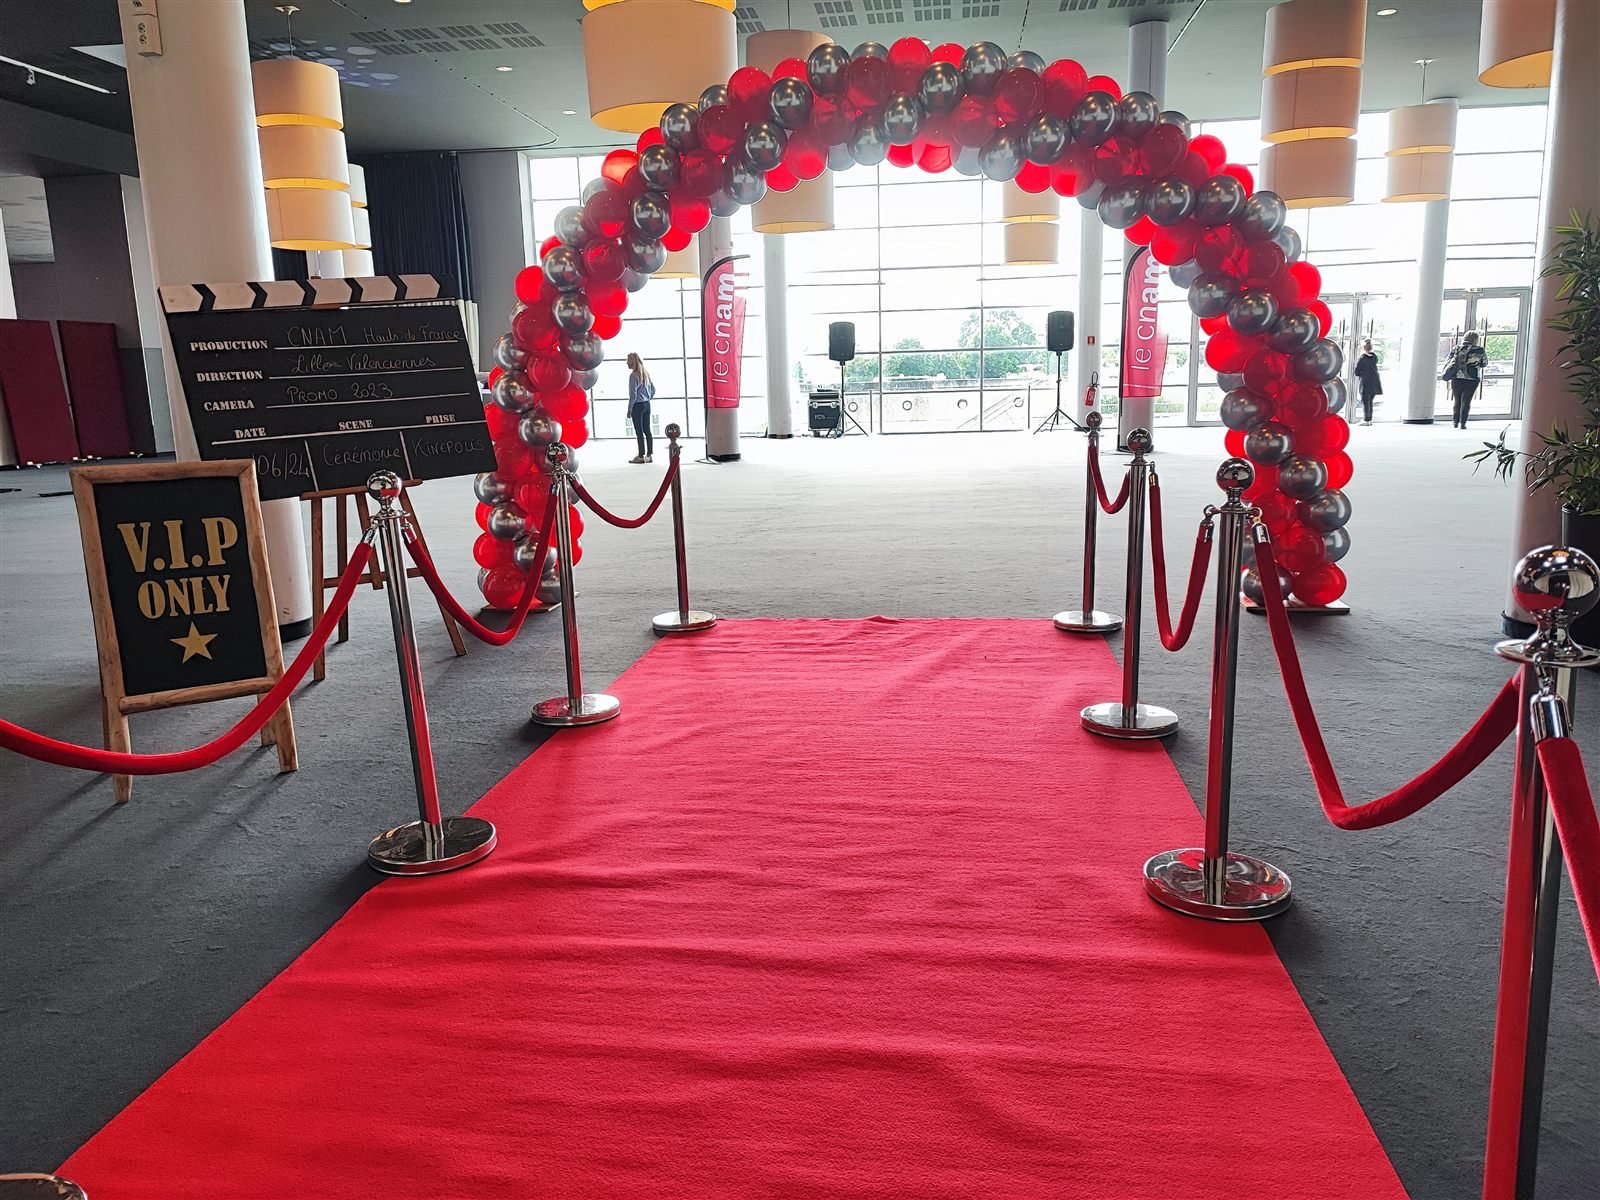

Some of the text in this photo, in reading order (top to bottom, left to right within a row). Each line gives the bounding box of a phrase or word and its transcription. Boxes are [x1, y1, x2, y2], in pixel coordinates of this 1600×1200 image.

[1137, 254, 1160, 341] cnam
[714, 273, 735, 355] cnam
[287, 323, 464, 346] CNAM Hauts de France
[190, 340, 268, 351] PRODUCTION
[346, 353, 436, 371] Valenciennes
[1131, 350, 1152, 371] le
[196, 370, 263, 382] DIRECTION
[711, 361, 729, 384] le
[351, 382, 393, 399] 2023
[203, 400, 255, 411] CAMERA
[338, 419, 374, 431] SCENE
[425, 414, 456, 424] PRISE
[234, 427, 267, 439] DATE
[252, 449, 310, 481] 06/24
[117, 516, 238, 573] V.I.P
[137, 574, 230, 619] ONLY
